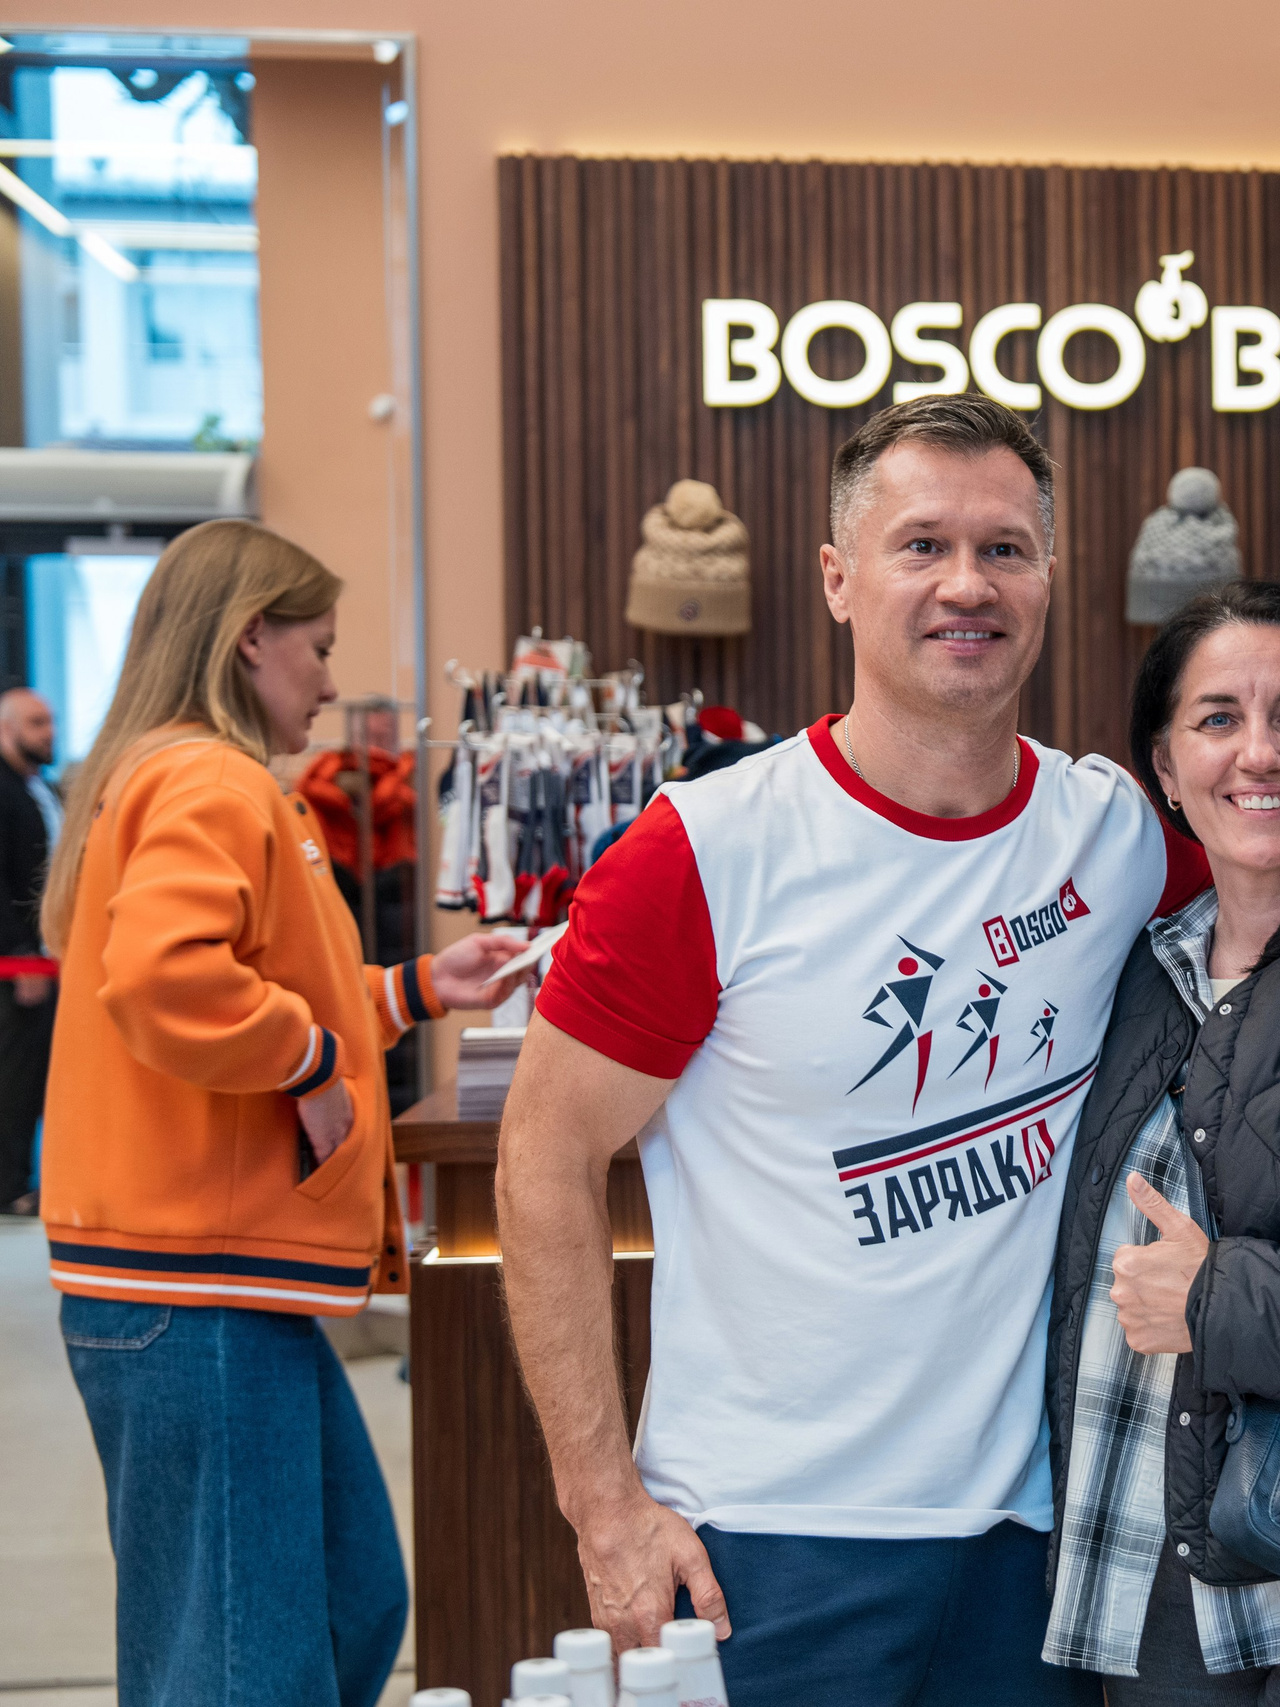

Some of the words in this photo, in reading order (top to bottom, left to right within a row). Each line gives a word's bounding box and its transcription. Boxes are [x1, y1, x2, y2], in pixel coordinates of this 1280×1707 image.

[702, 298, 1146, 409] BOSCO
[982, 900, 1068, 967] BOSCO
[844, 1118, 1055, 1247] ЗАРЯДКА
